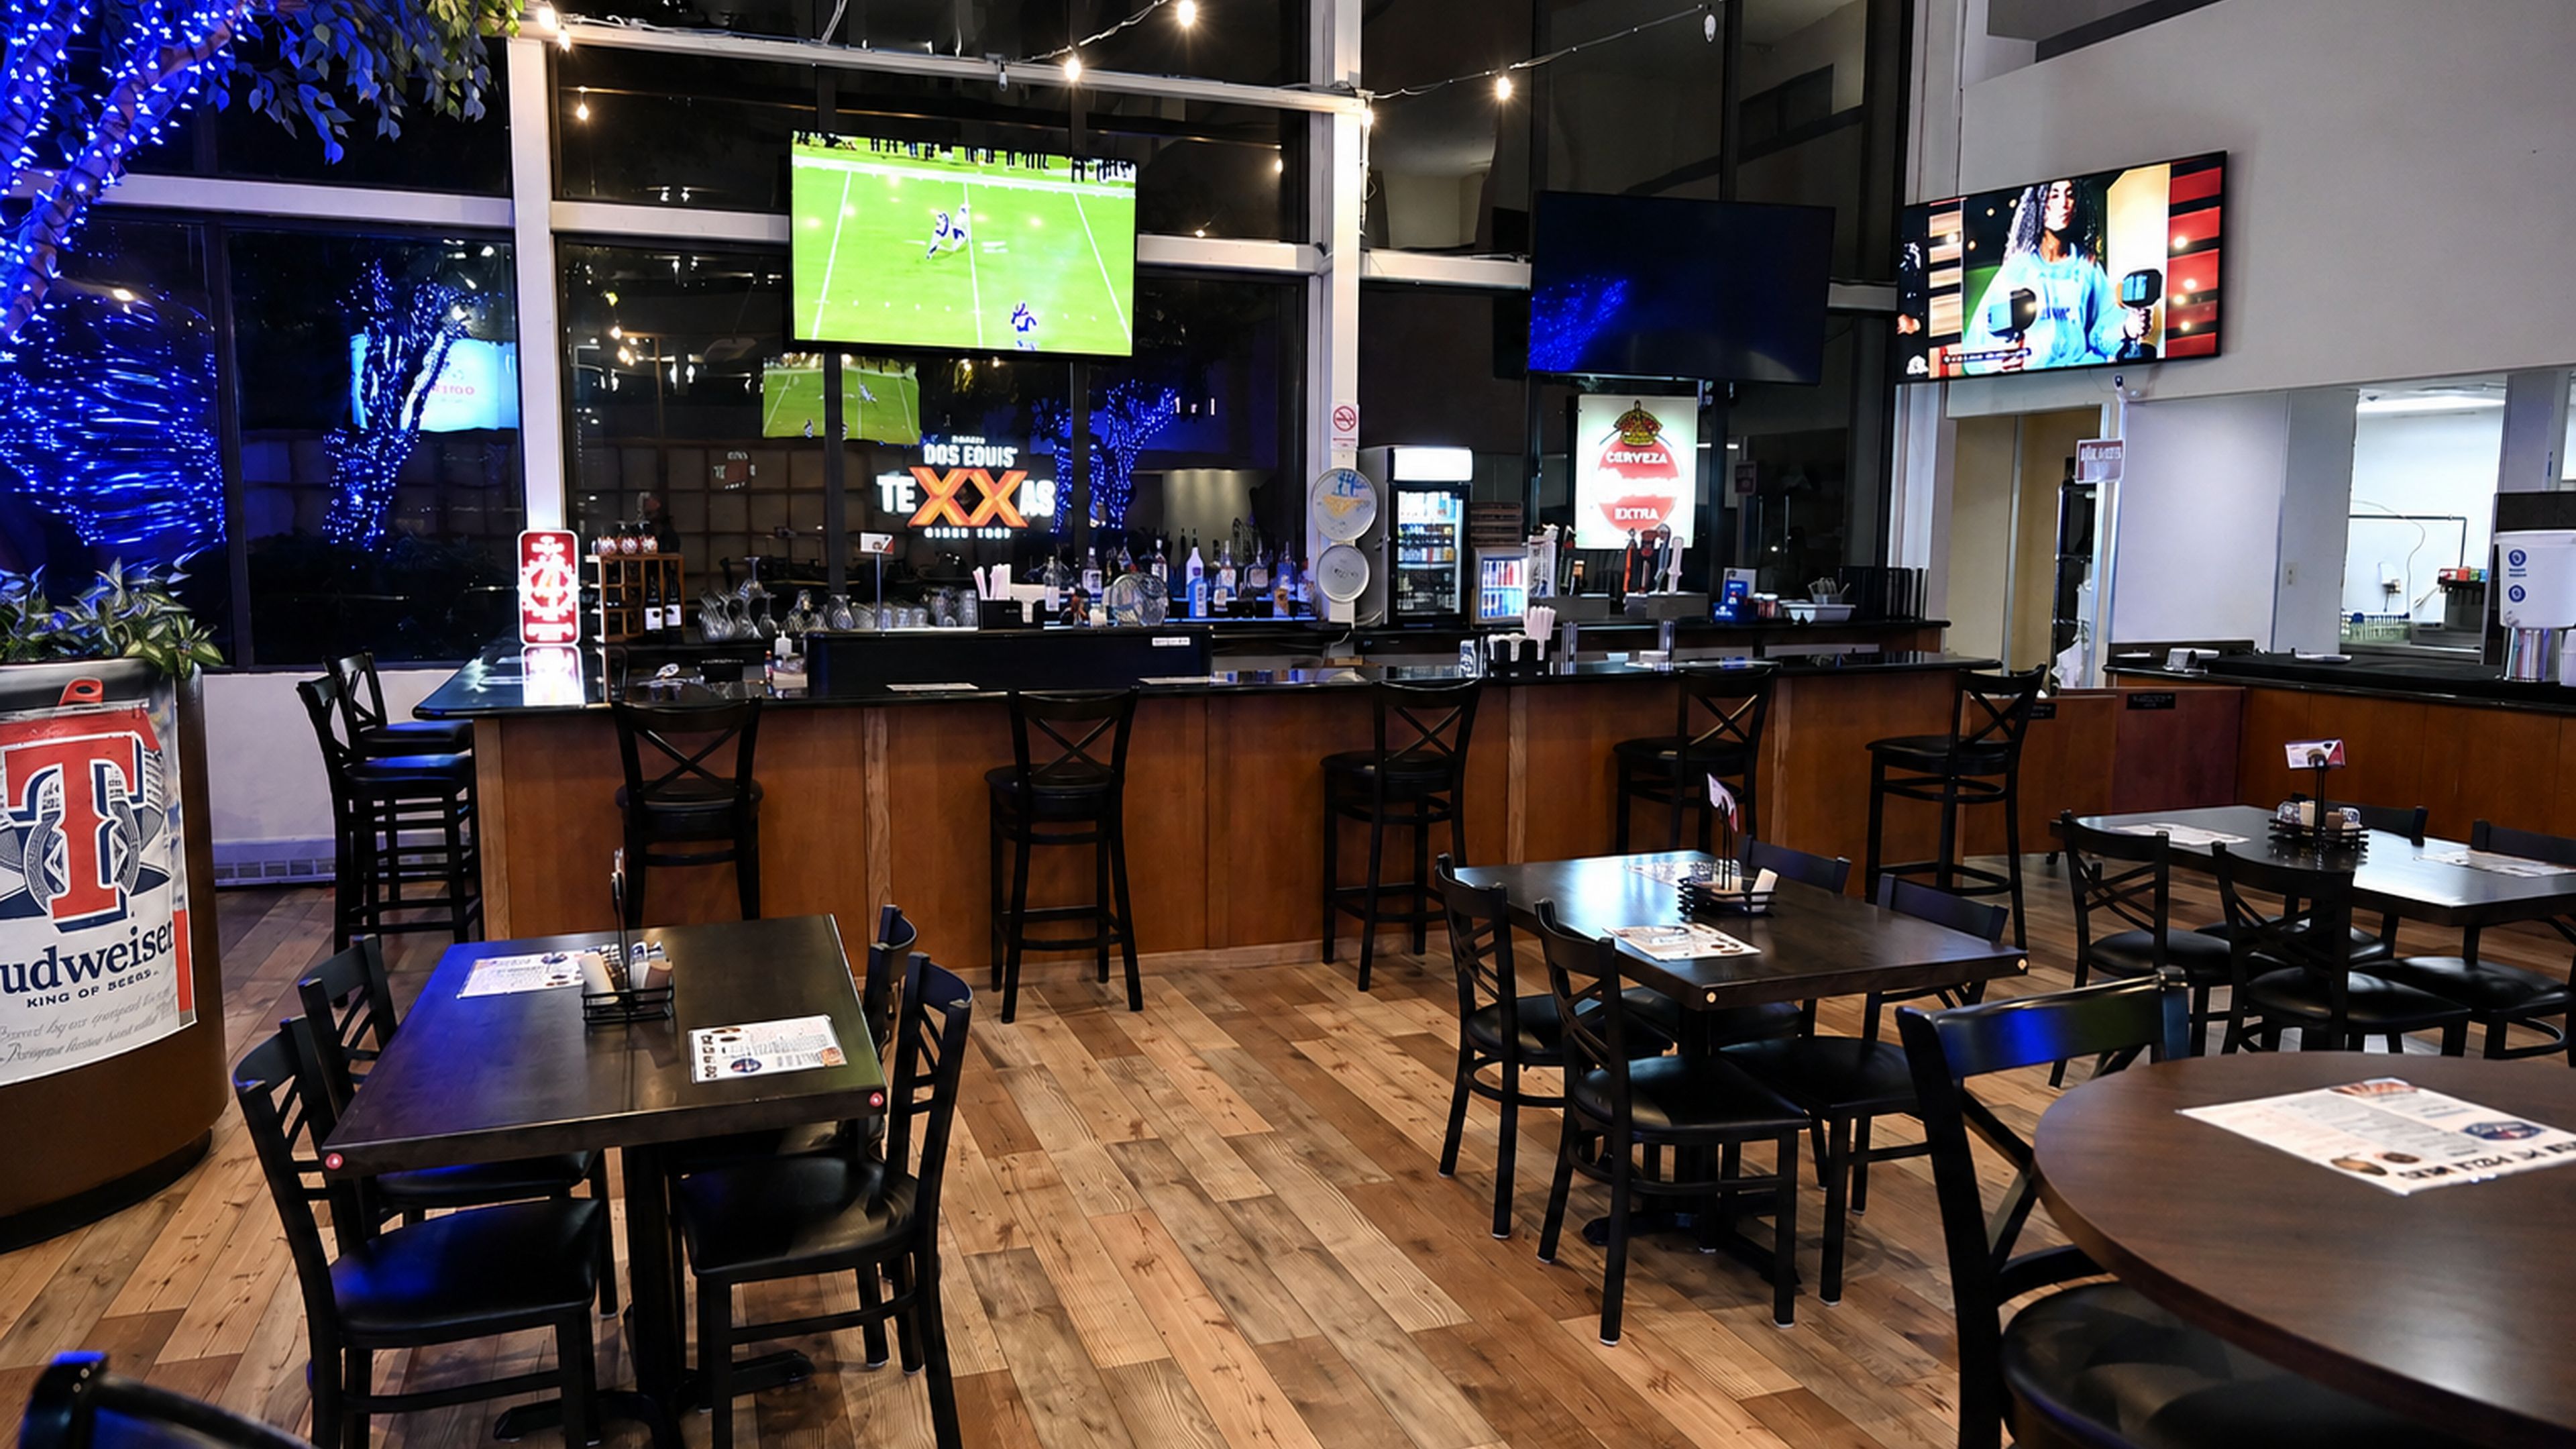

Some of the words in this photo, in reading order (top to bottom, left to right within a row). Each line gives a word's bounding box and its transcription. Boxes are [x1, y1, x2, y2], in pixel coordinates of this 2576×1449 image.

[924, 443, 960, 466] DOS
[1606, 451, 1668, 464] CERVEZA
[1614, 508, 1660, 520] EXTRA
[2, 731, 145, 933] T
[0, 920, 174, 994] udweiser
[27, 993, 70, 1008] KING
[78, 985, 100, 999] OF
